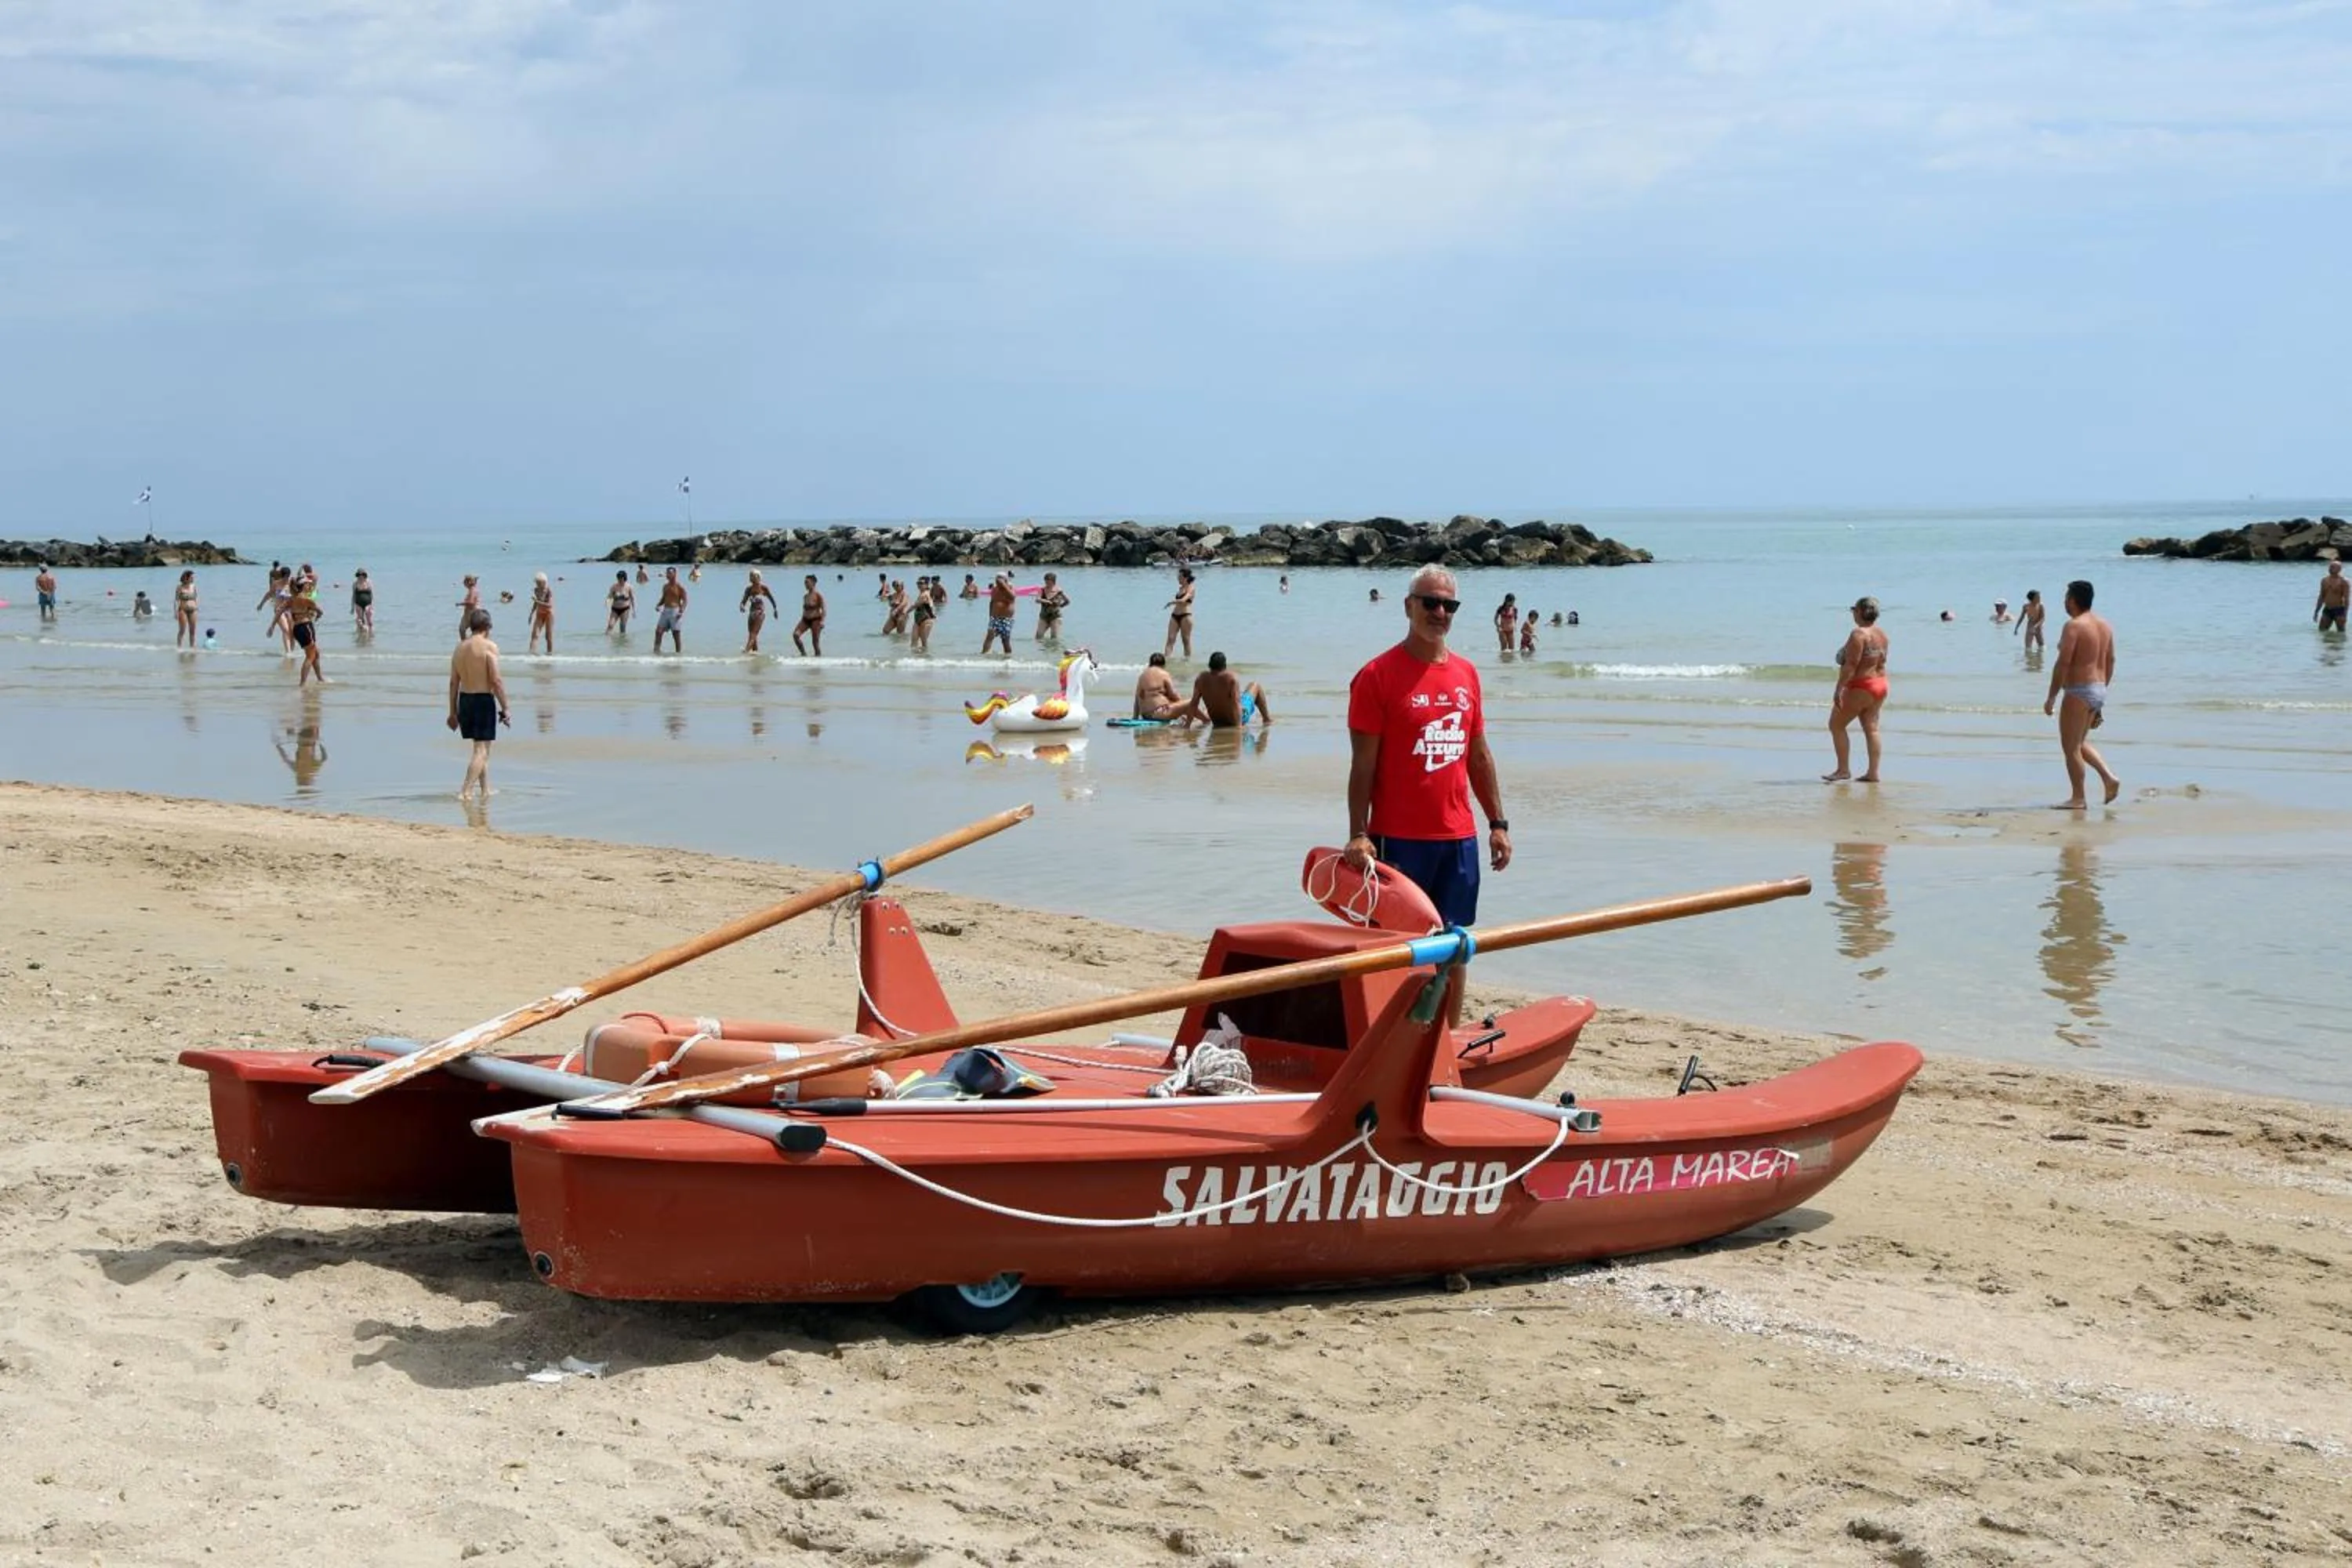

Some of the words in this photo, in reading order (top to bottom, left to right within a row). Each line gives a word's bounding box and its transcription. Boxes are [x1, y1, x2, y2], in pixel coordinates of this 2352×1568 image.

[1425, 723, 1465, 742] Radio
[1153, 1161, 1508, 1227] SALVATAGGIO
[1567, 1157, 1653, 1199] ALTA
[1671, 1147, 1795, 1187] MAREA
